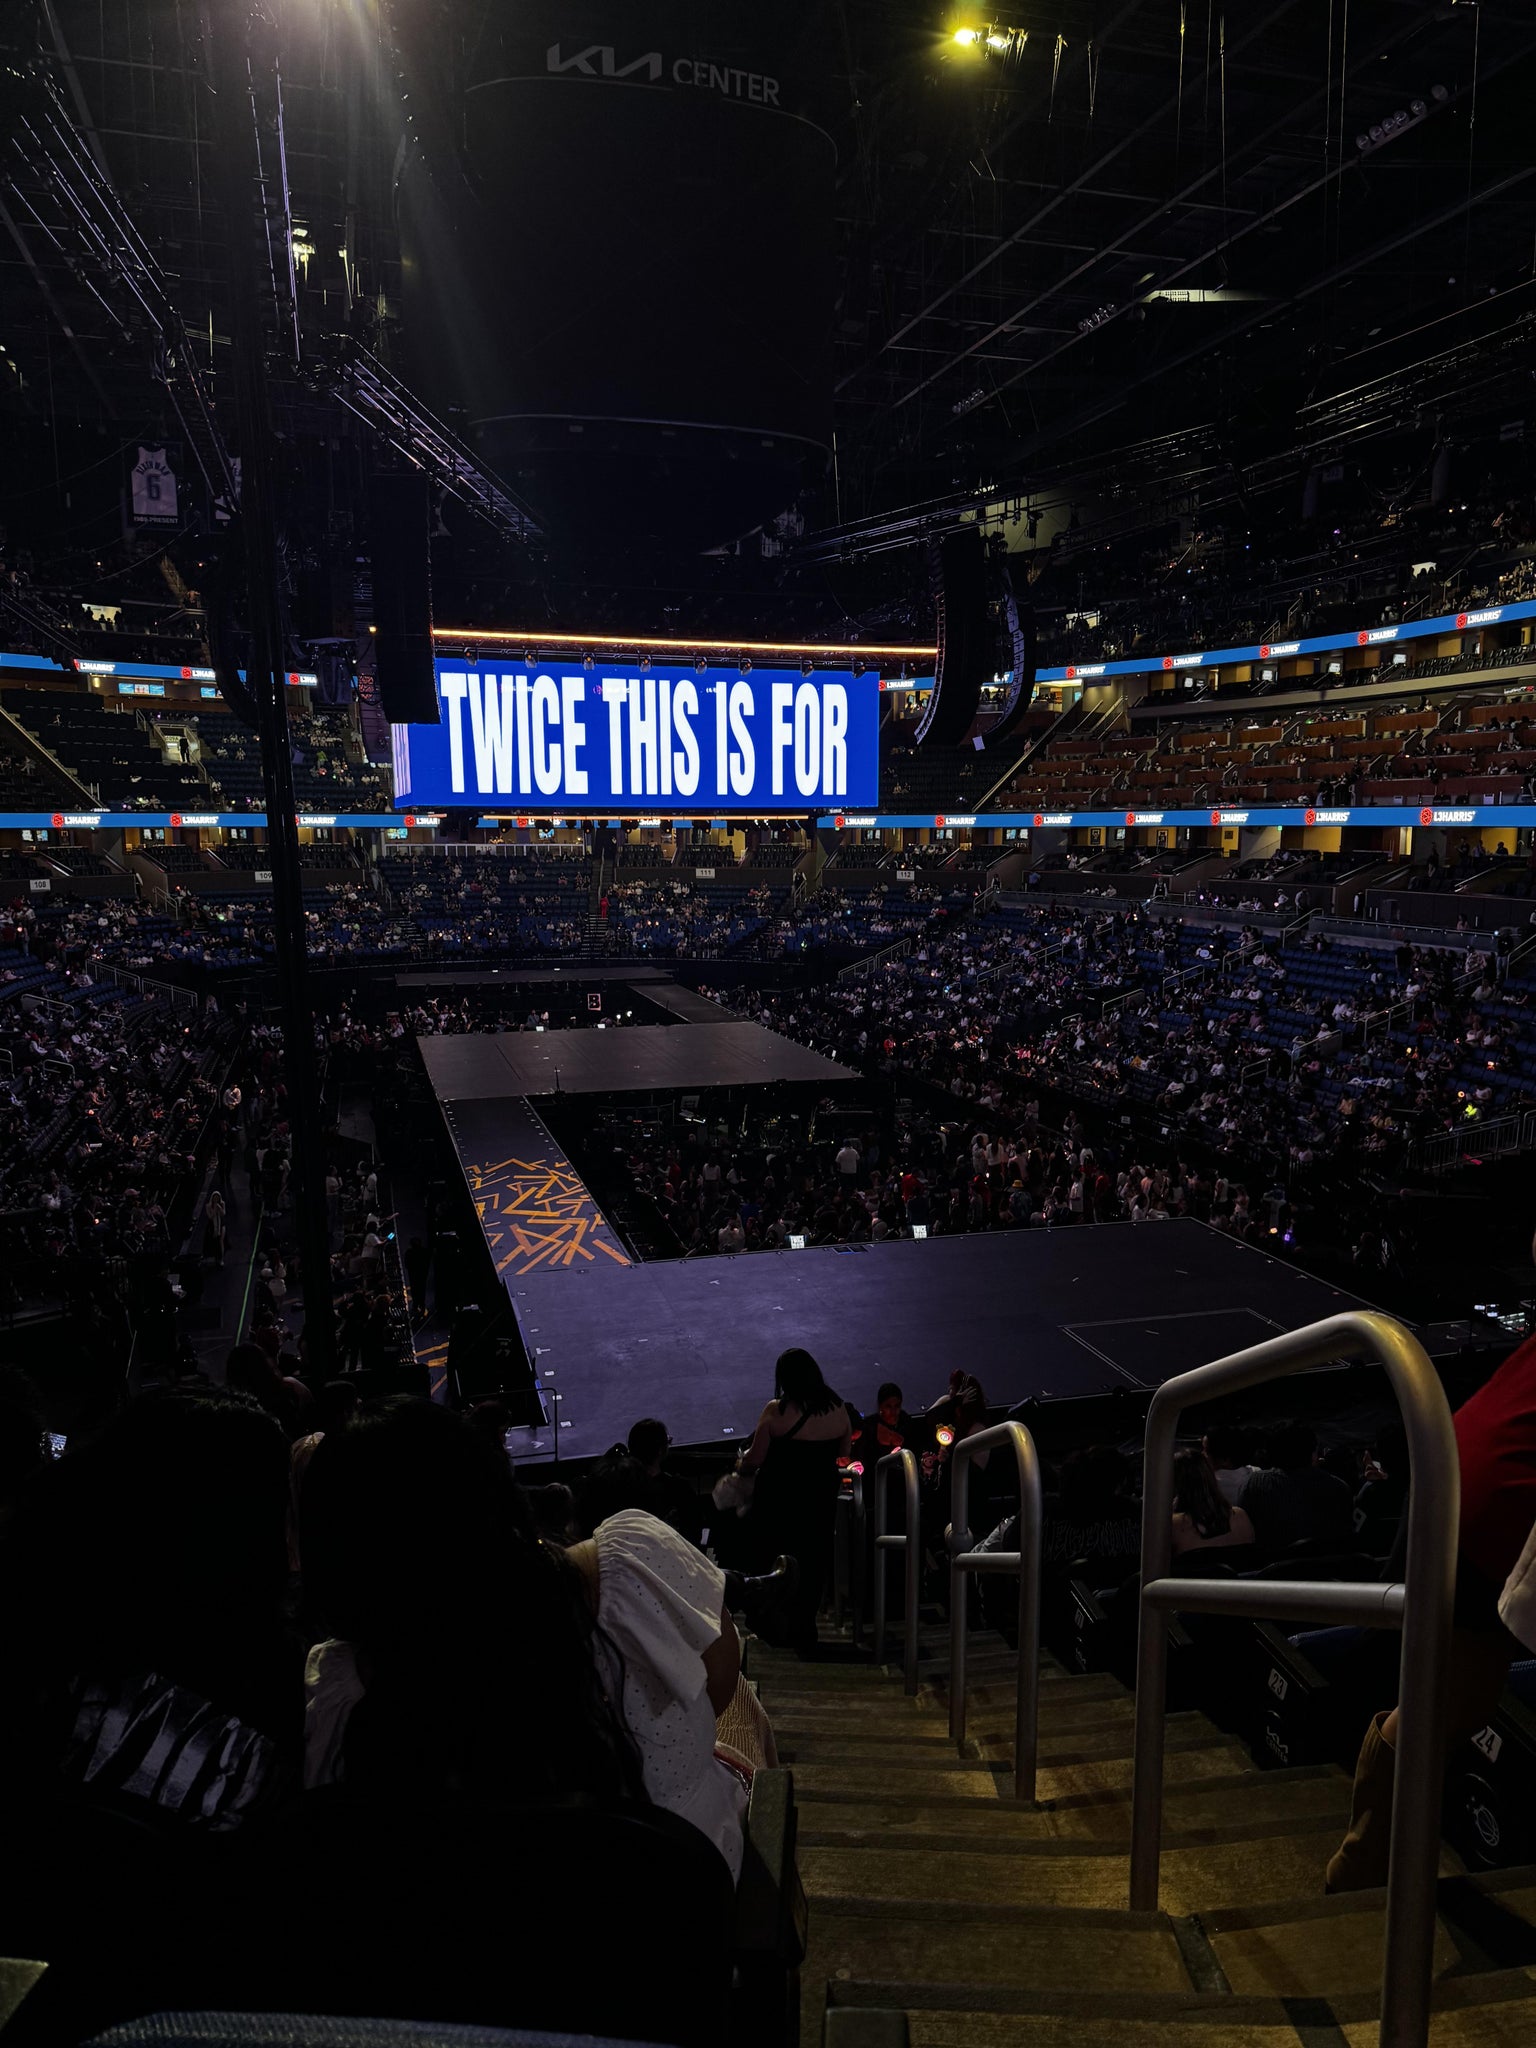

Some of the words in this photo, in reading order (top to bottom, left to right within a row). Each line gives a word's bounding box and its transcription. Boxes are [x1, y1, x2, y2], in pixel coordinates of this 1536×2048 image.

[672, 58, 780, 106] CENTER
[148, 474, 160, 500] 6
[1467, 610, 1502, 625] L3HARRIS
[1369, 628, 1399, 641] L3HARRIS
[1268, 644, 1300, 657] L3HARRIS
[80, 662, 115, 672] L3HARRIS
[1173, 656, 1203, 668] L3HARRIS
[1075, 666, 1105, 677] L3HARRIS
[886, 680, 915, 691] L3HARRIS
[440, 672, 588, 795] TWICE
[603, 678, 700, 796] THIS
[716, 681, 755, 796] IS
[772, 683, 848, 796] FOR
[64, 816, 101, 824] L3HARRIS
[182, 816, 219, 824] L3HARRIS
[845, 818, 876, 826] L3HARRIS
[946, 817, 976, 825] L3HARRIS
[1043, 815, 1072, 824] L3HARRIS
[1135, 814, 1163, 823] L3HARRIS
[1220, 813, 1249, 822] L3HARRIS
[1316, 812, 1350, 822] L3HARRIS
[1433, 811, 1475, 822] L3HARRIS
[1271, 1673, 1284, 1695] 23
[1476, 1727, 1495, 1754] 24
